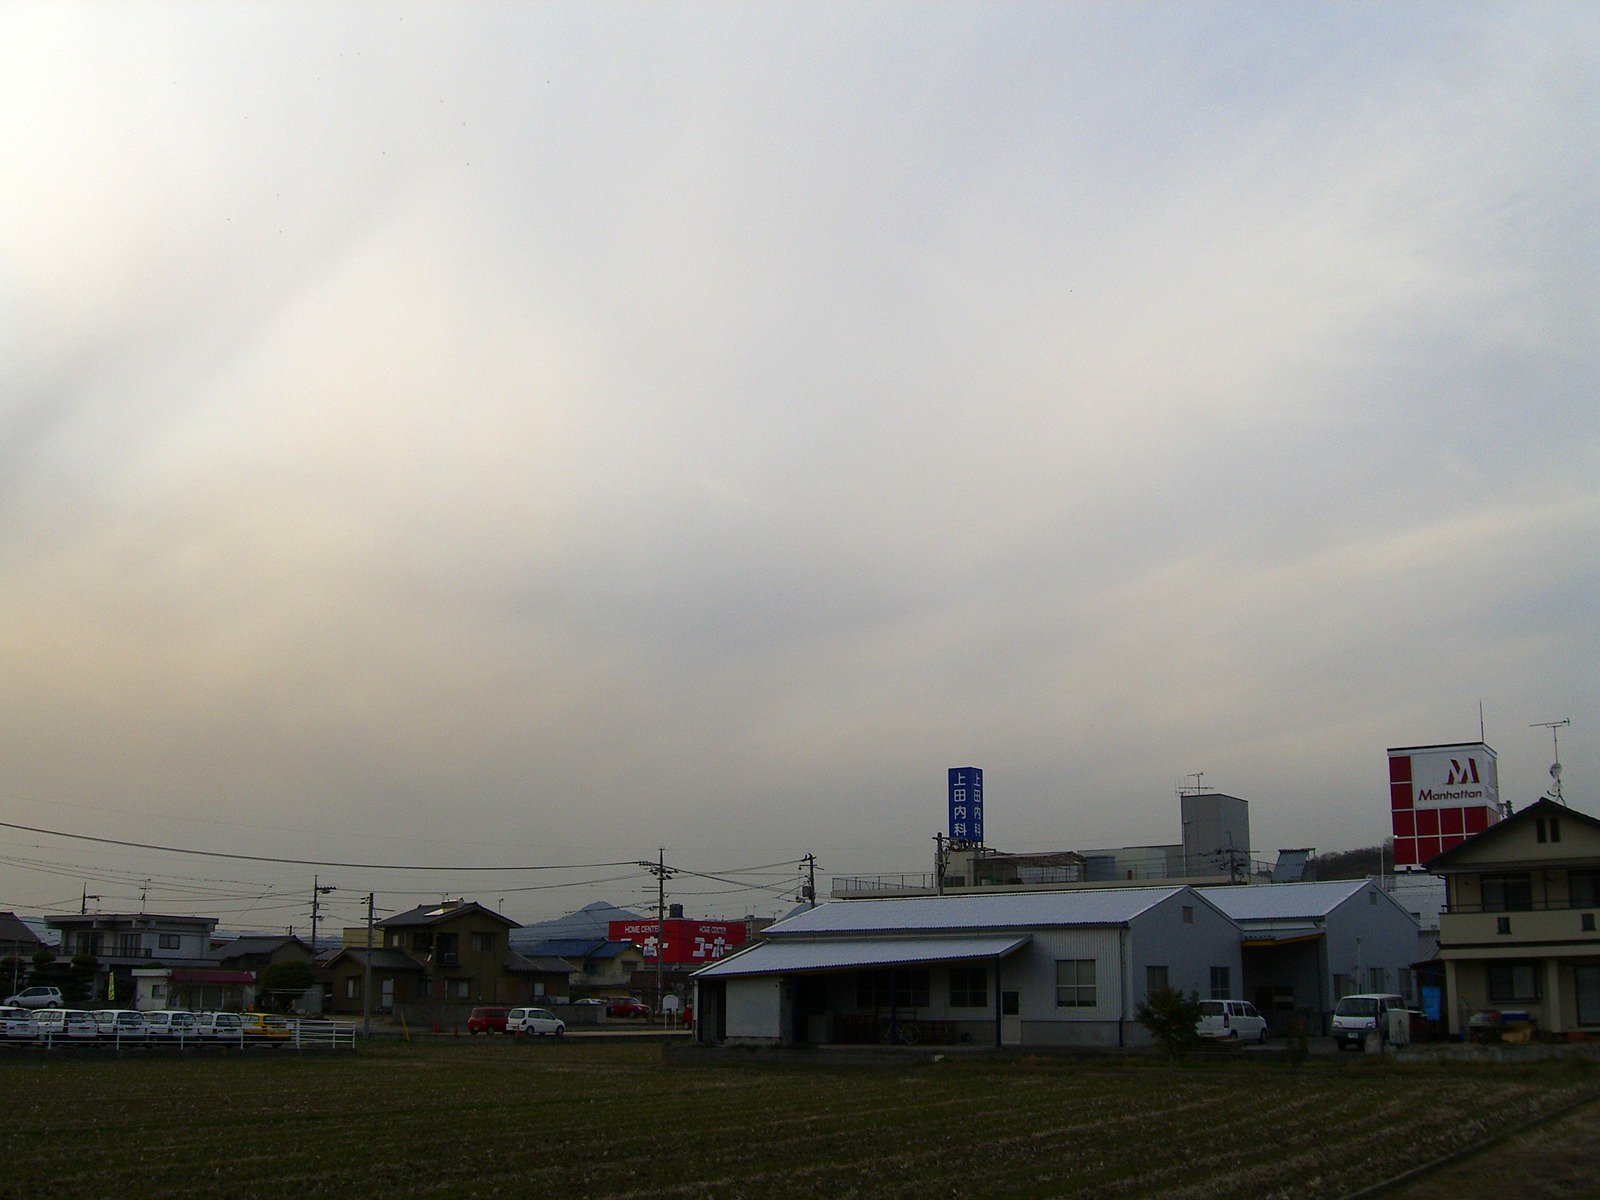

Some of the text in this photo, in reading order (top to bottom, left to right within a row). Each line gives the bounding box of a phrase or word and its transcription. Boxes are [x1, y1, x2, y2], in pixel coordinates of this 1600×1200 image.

[953, 772, 967, 836] 上田内科
[973, 773, 982, 836] 上田内科
[1418, 789, 1482, 801] Manhattan
[624, 925, 659, 934] HOME CENTE
